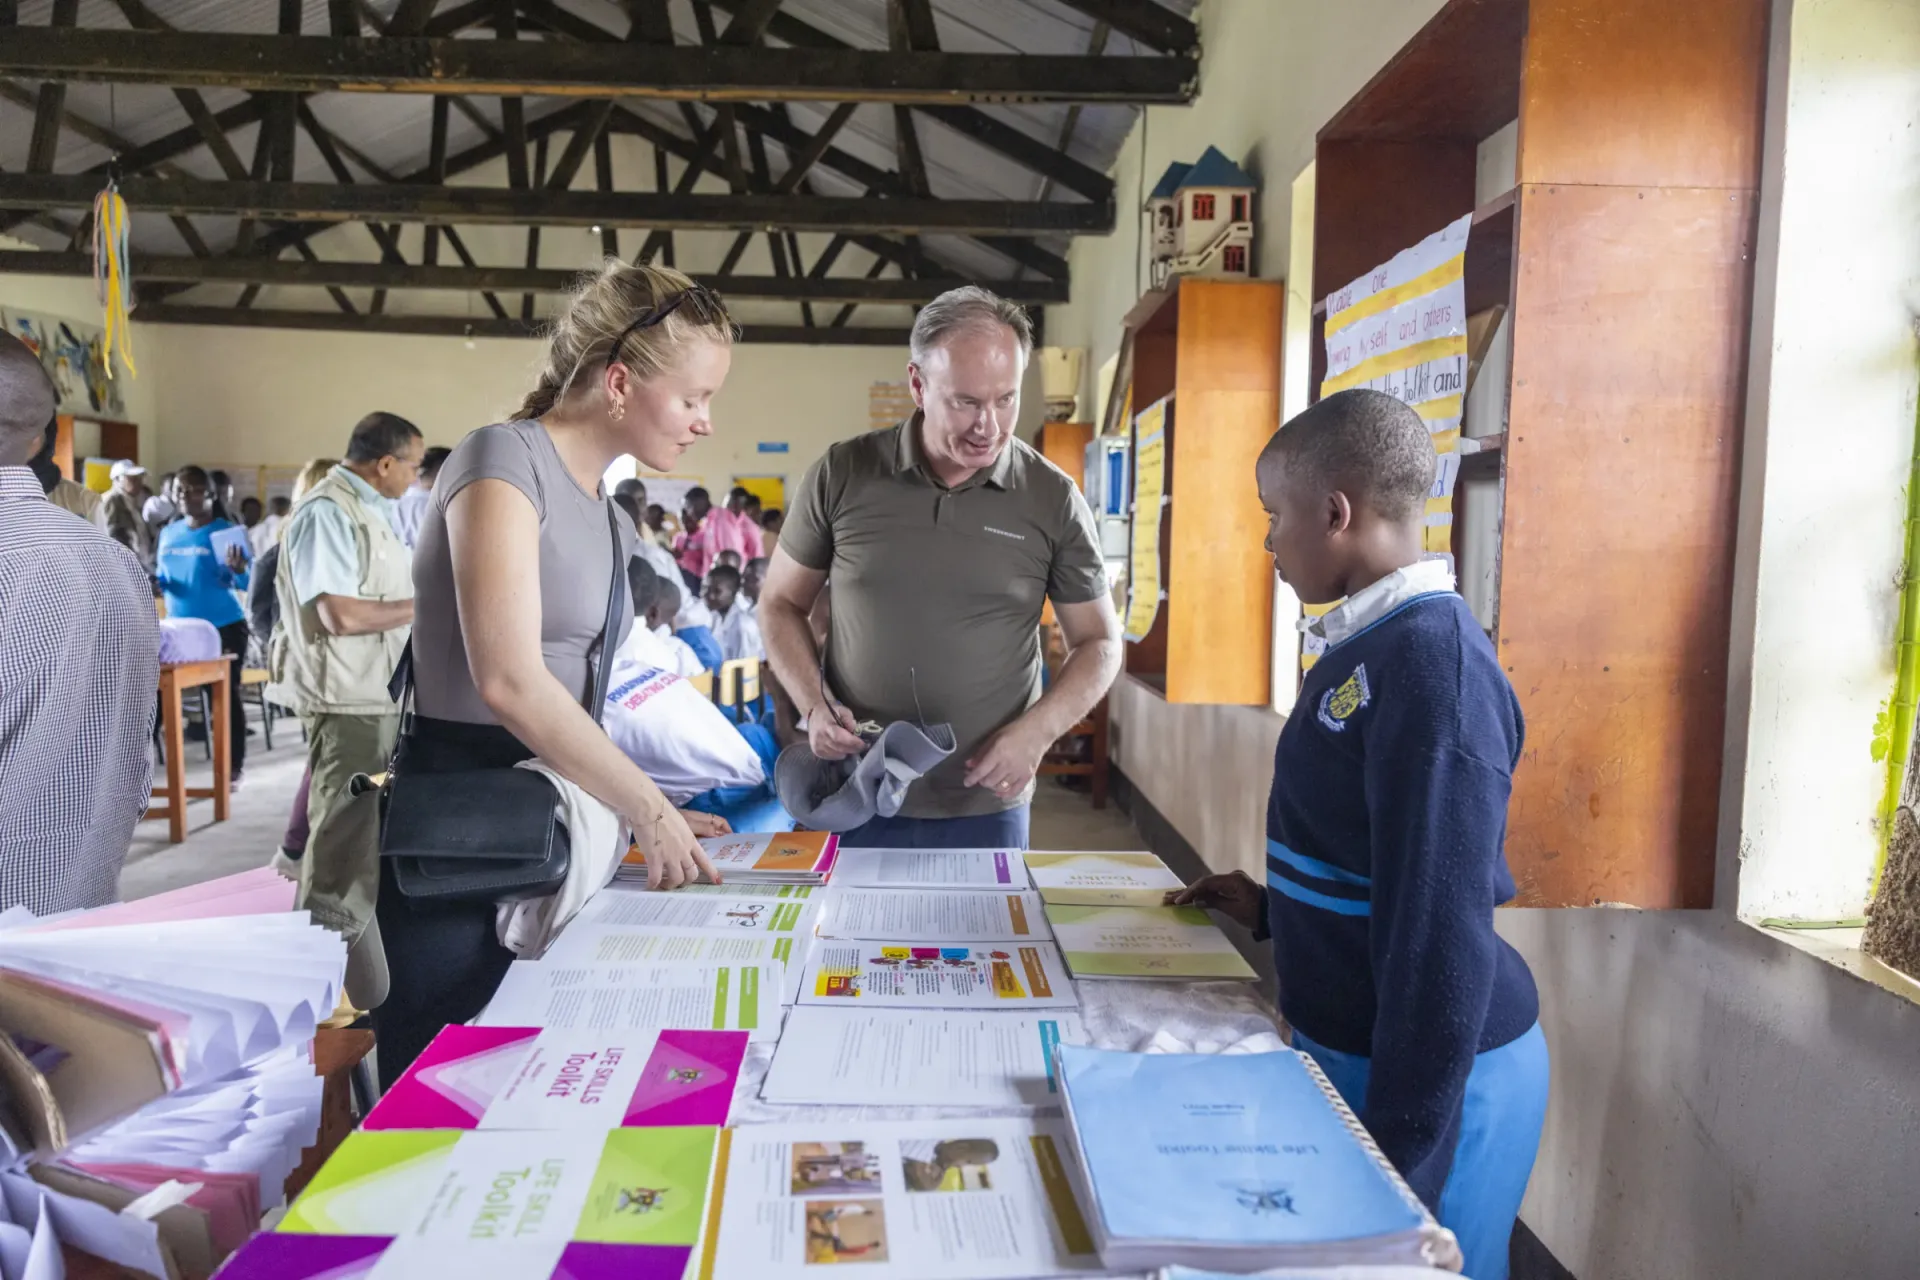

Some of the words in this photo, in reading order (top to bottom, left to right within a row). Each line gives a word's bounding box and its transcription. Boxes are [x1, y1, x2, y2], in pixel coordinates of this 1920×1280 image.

[1434, 357, 1461, 393] and
[546, 1051, 597, 1098] Toolkit
[601, 1047, 625, 1068] LIFE
[580, 1067, 614, 1105] SKILLS
[470, 1166, 531, 1239] Toolkit
